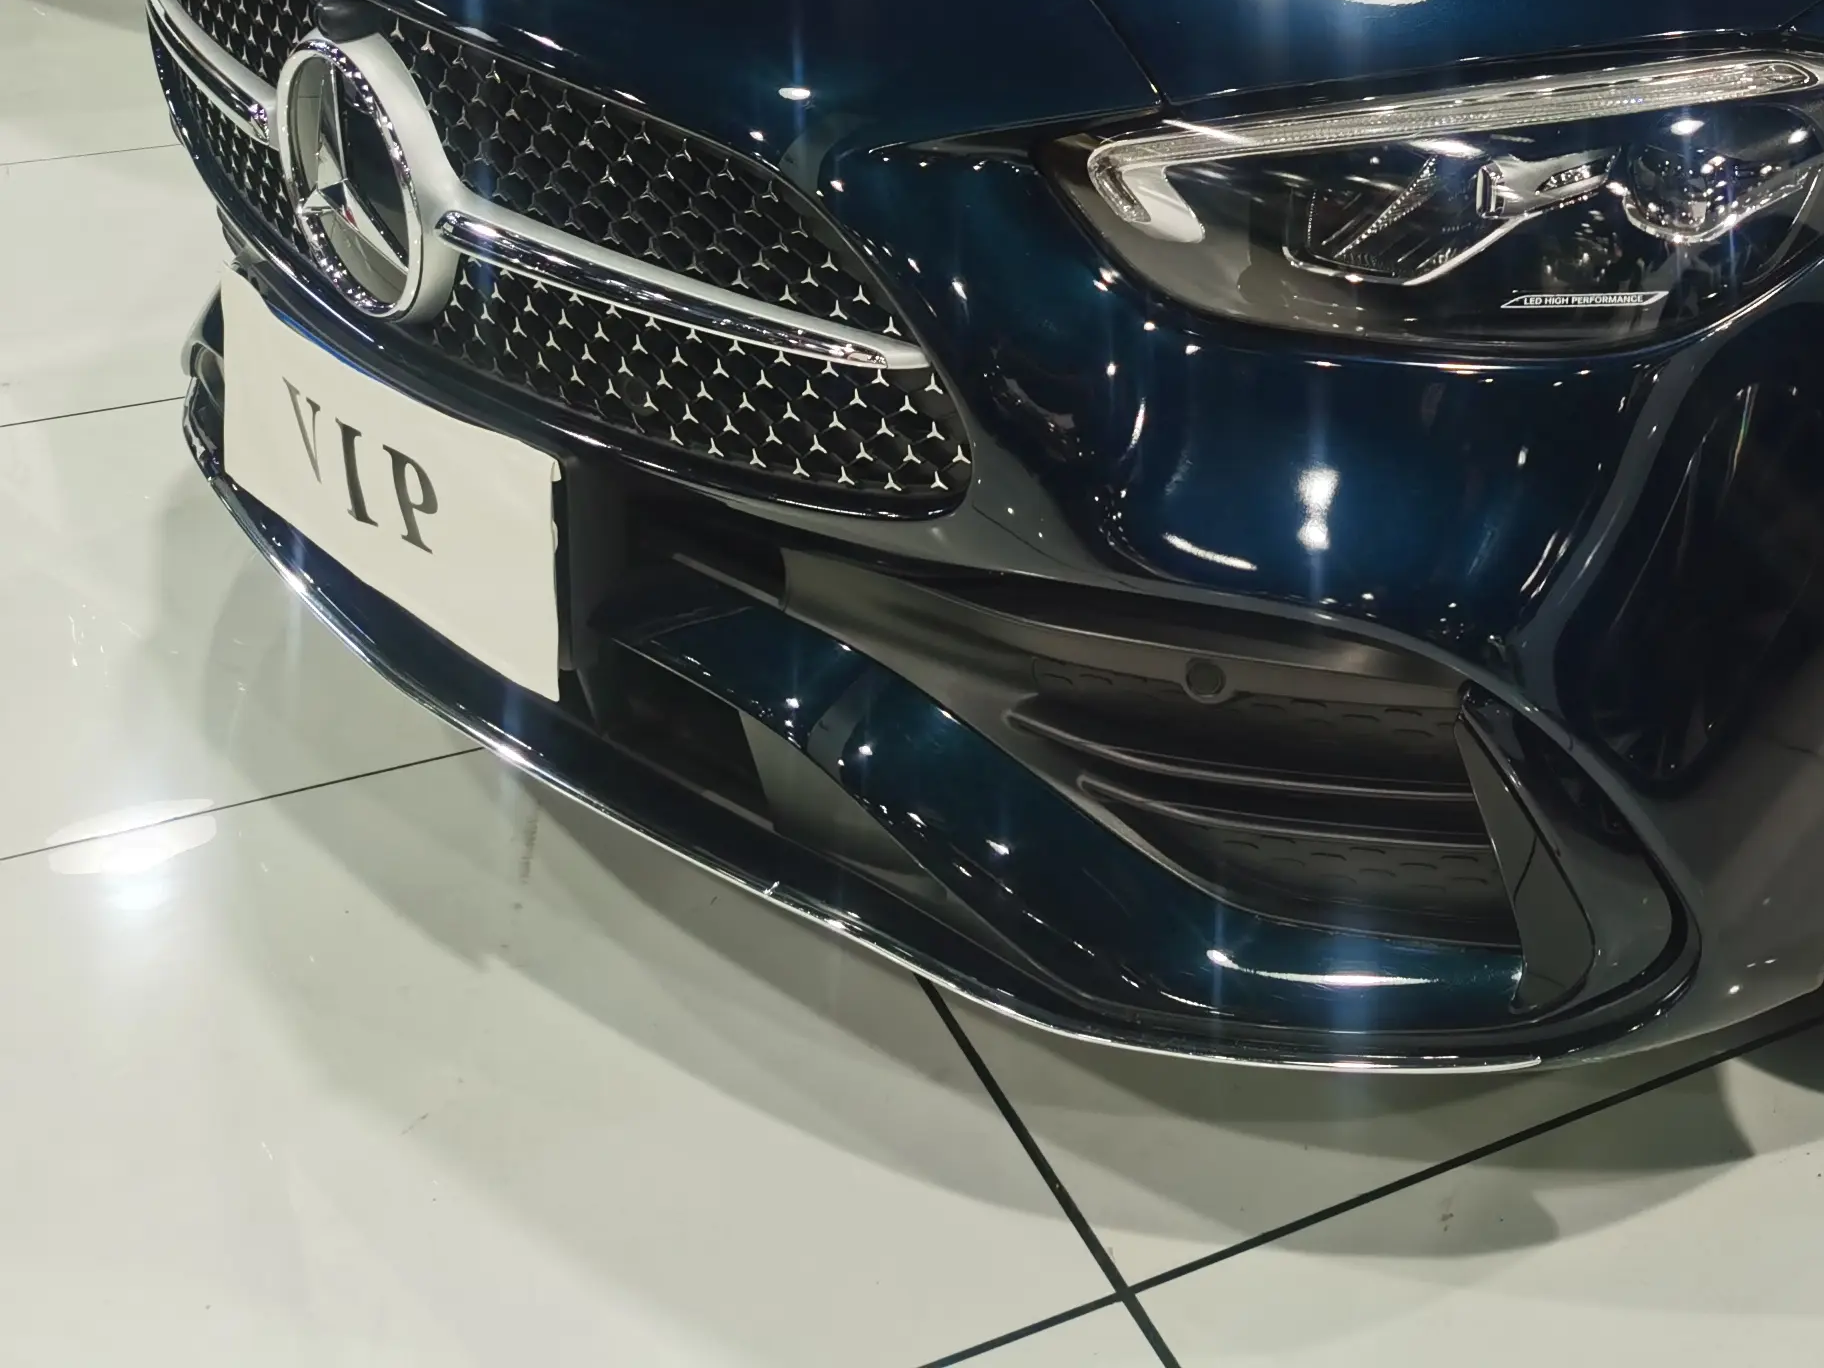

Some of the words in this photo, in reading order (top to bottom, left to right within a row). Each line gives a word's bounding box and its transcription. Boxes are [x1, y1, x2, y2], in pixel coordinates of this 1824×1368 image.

[1524, 297, 1542, 305] LED
[1545, 296, 1569, 305] HIGH
[1571, 295, 1643, 304] PERFORMANCE
[282, 376, 438, 554] VIP
